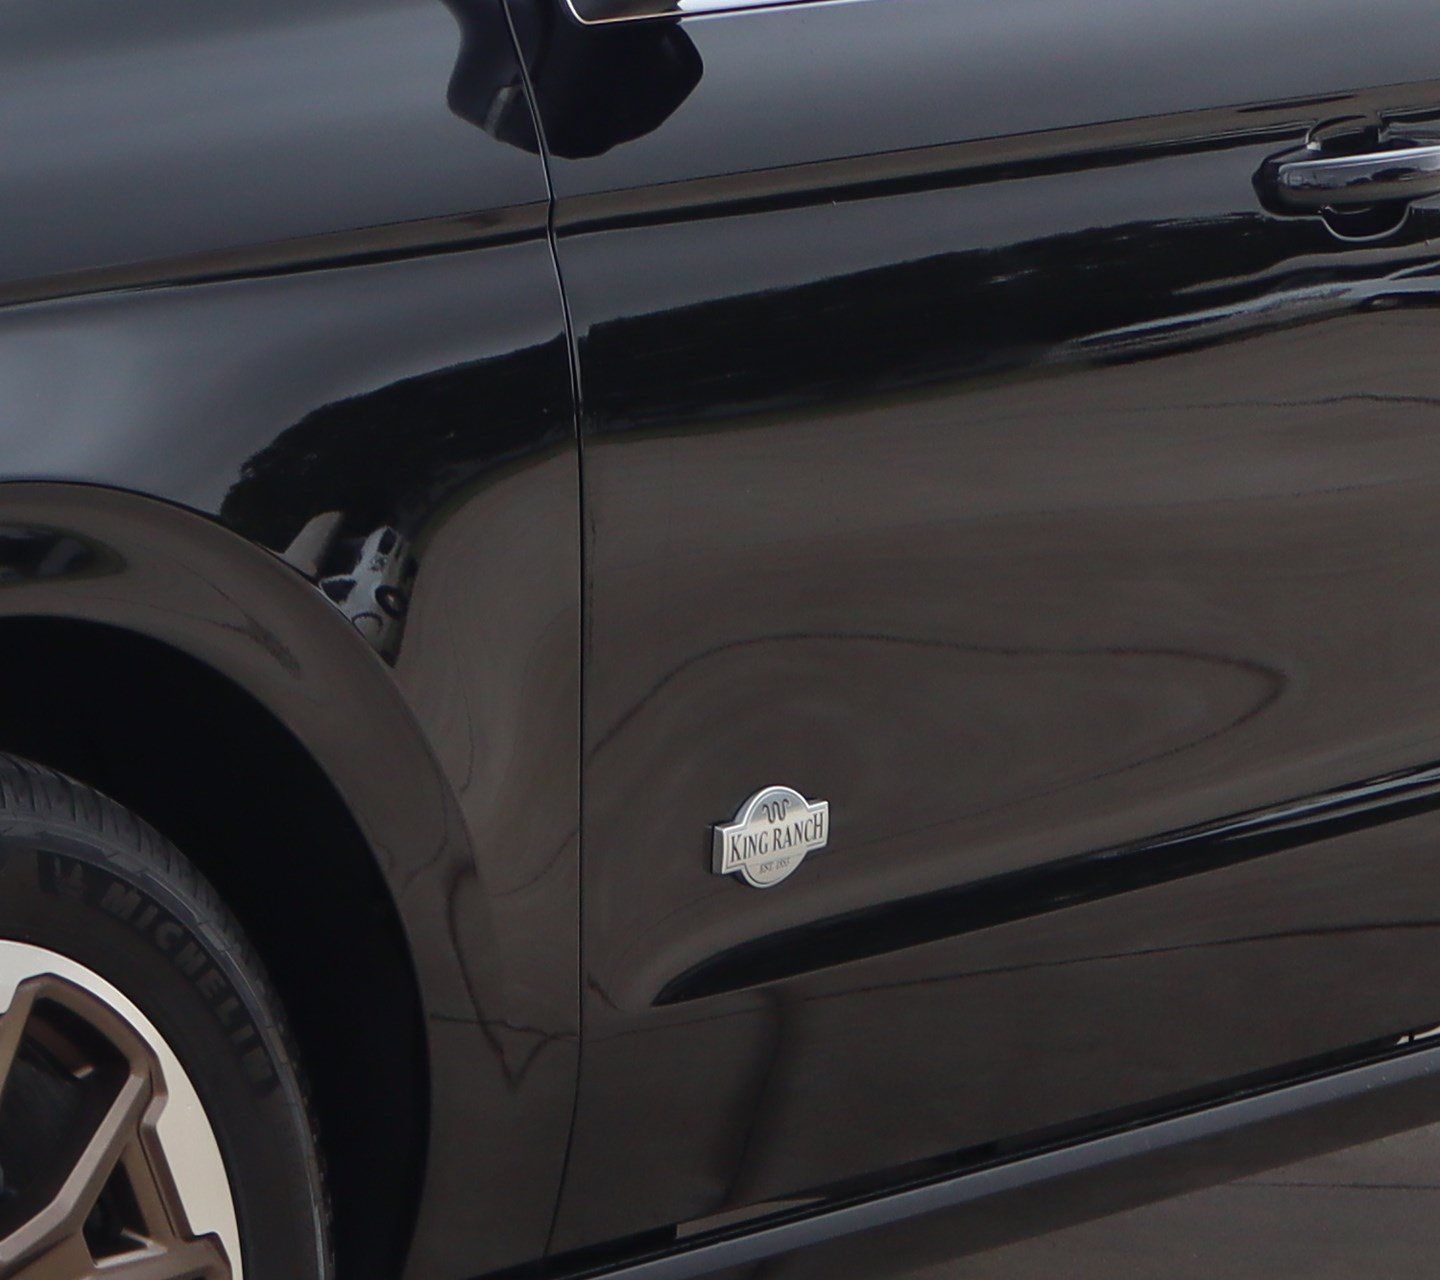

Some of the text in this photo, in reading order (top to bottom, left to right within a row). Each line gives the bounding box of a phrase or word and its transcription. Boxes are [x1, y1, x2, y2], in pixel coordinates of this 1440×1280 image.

[730, 812, 823, 862] KING RANCH
[99, 880, 279, 1086] MICHELIN
